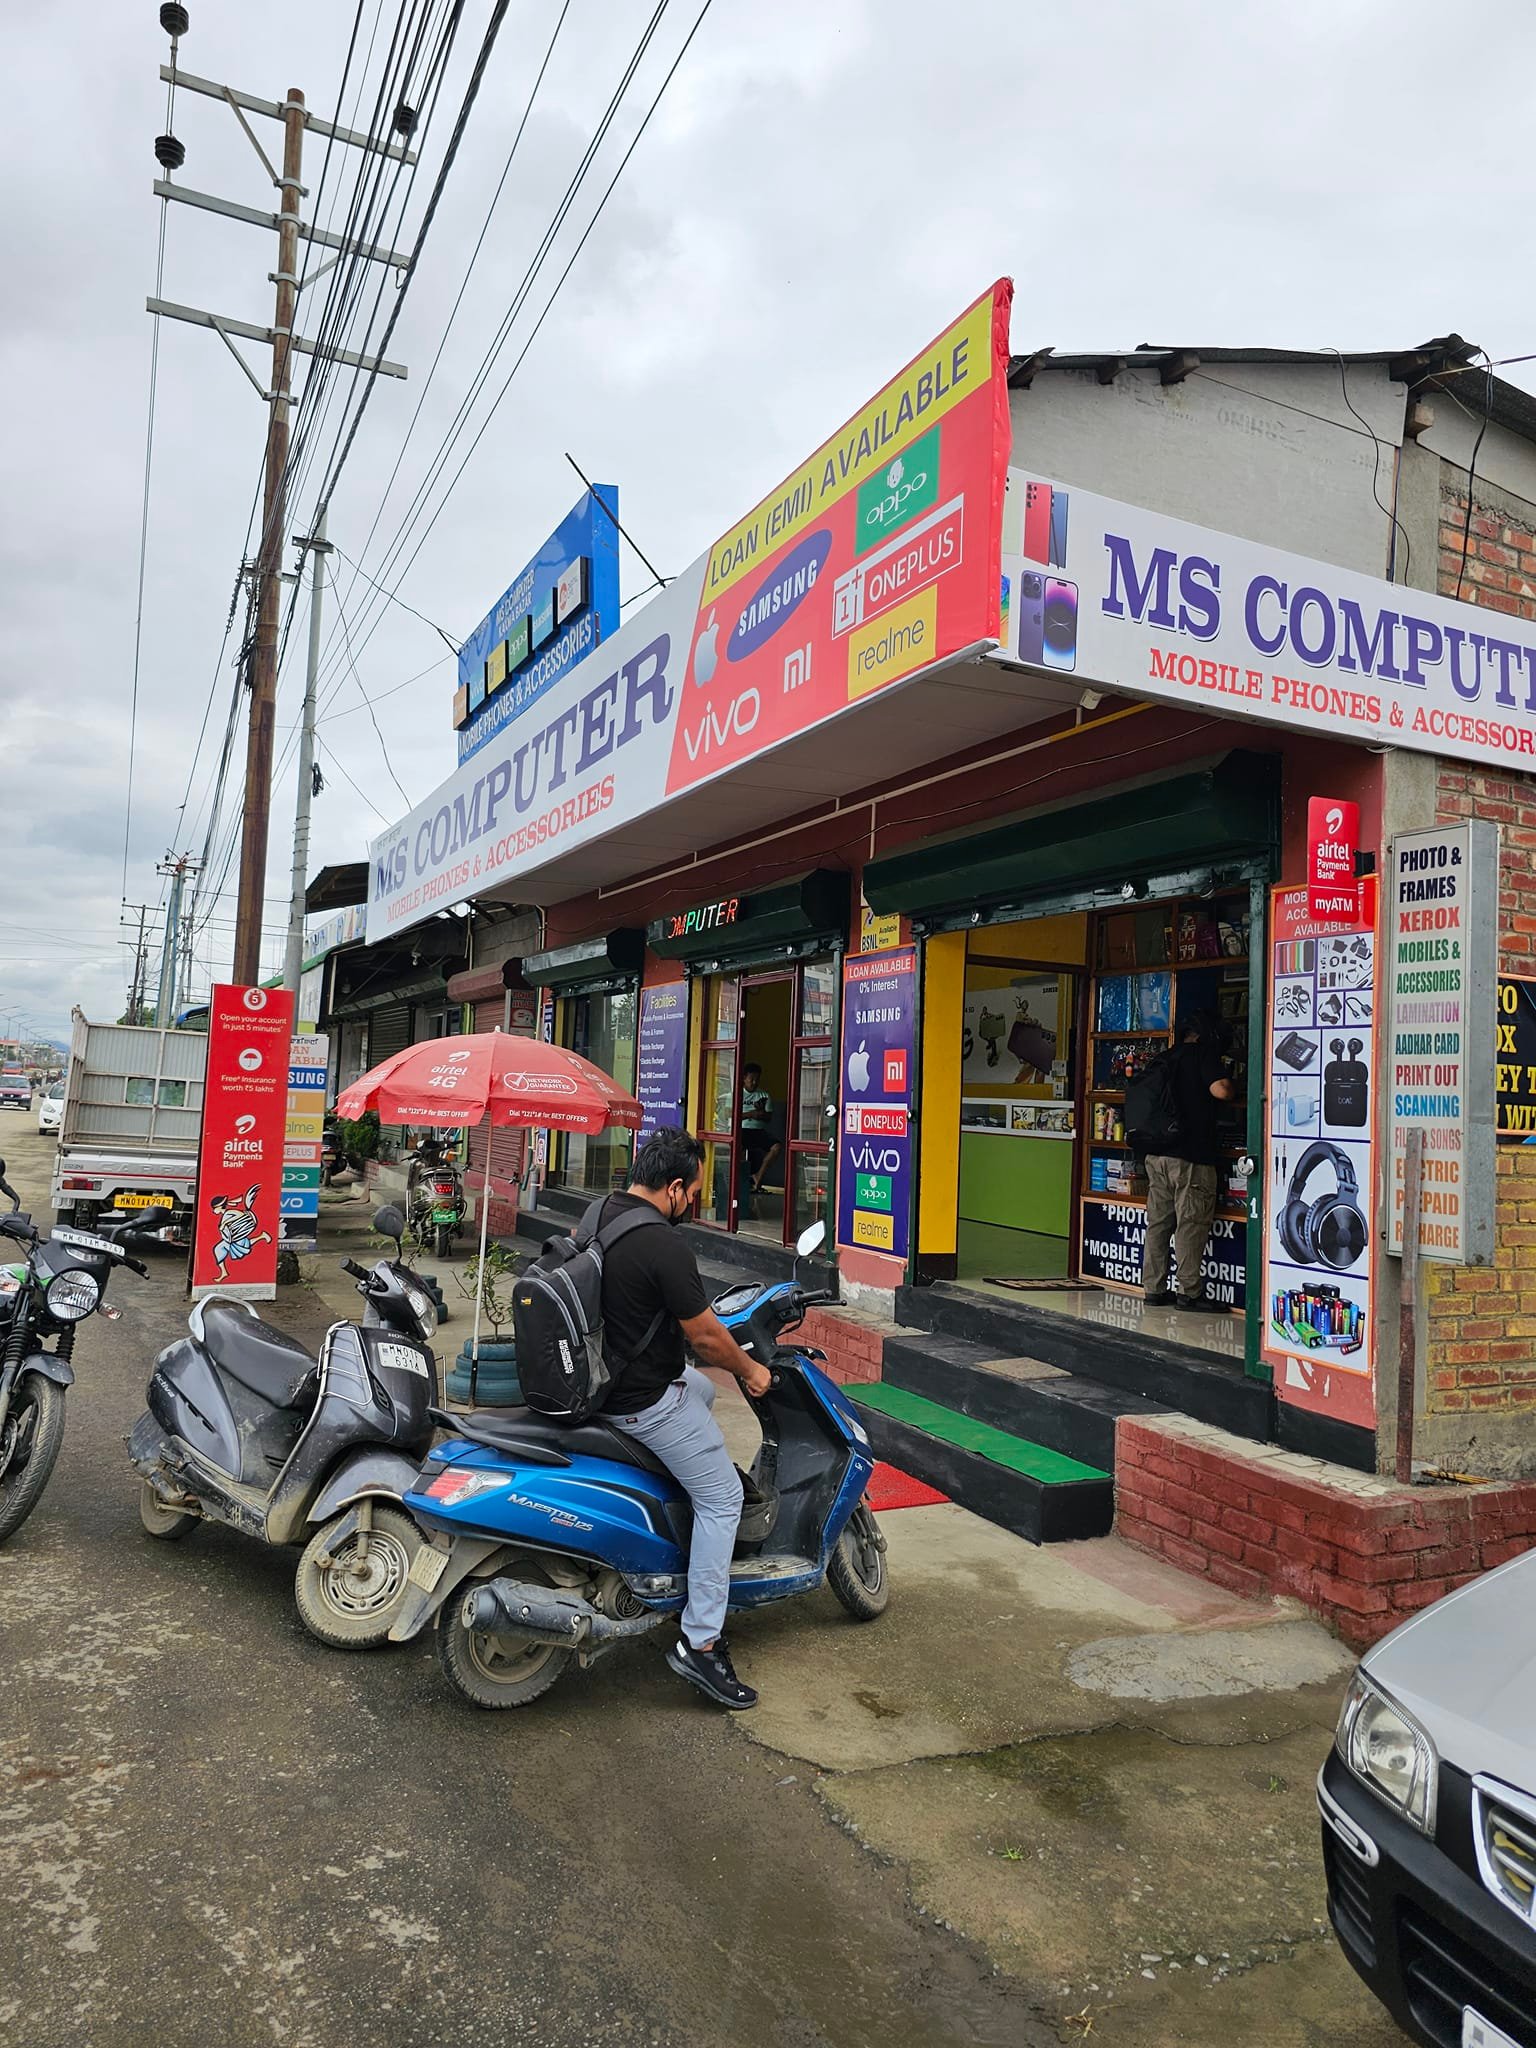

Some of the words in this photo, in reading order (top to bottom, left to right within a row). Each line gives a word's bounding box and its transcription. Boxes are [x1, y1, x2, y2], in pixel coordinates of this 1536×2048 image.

[710, 521, 759, 588] LOAN
[765, 477, 814, 544] (EMI)
[820, 337, 970, 496] AVAILABLE
[866, 471, 928, 531] oppo
[869, 527, 955, 603] ONEPLUS
[737, 559, 819, 637] SAMSUNG
[1101, 533, 1221, 643] MS
[857, 618, 926, 677] realme
[459, 715, 483, 755] MOBILE
[483, 687, 515, 735] PHONES
[515, 679, 524, 706] &
[524, 613, 592, 699] ACCESSORIES
[1148, 648, 1263, 701] MOBILE
[1272, 674, 1381, 724] PHONES
[1389, 700, 1404, 728] &
[1412, 706, 1536, 756] ACCESSOR
[683, 686, 761, 762] vivo
[374, 837, 409, 903] MS
[415, 632, 674, 877] COMPUTER
[386, 888, 421, 924] MOBILE
[422, 859, 470, 905] PHONES
[472, 854, 482, 878] &
[485, 773, 615, 872] ACCESSORIES
[1317, 840, 1350, 860] airtel
[1317, 858, 1349, 872] Payments
[1399, 845, 1448, 873] PHOTO
[1451, 846, 1462, 866] &
[1317, 869, 1335, 880] Bank
[1399, 875, 1456, 904] FRAMES
[1315, 897, 1353, 914] myATM
[1294, 921, 1352, 937] AVAILABLE
[1399, 906, 1460, 933] XEROX
[879, 926, 898, 934] Available
[861, 933, 879, 952] BSNL
[1398, 939, 1449, 964] MOBILES
[1451, 940, 1461, 960] &
[848, 965, 869, 979] LOAN
[869, 957, 912, 976] AVAILABLE
[859, 981, 870, 994] 0%
[871, 978, 898, 993] Interest
[1396, 969, 1461, 994] ACCESSORIES
[251, 994, 259, 1003] 5
[650, 994, 677, 1009] Facilities
[220, 1013, 240, 1023] Open
[855, 1006, 901, 1025] SAMSUNG
[1396, 1001, 1459, 1024] LAMINATION
[230, 1023, 245, 1031] just
[1395, 1033, 1432, 1055] AADHAR
[1434, 1032, 1460, 1055] CARD
[241, 1075, 277, 1084] Insurance
[288, 1071, 326, 1085] SUNG
[431, 1064, 468, 1076] airtel
[1395, 1064, 1431, 1086] PRINT
[1434, 1064, 1459, 1087] OUT
[254, 1085, 274, 1093] lakhs
[428, 1075, 459, 1089] 4G
[529, 1082, 571, 1090] GUARANTEE
[428, 1109, 437, 1117] for
[437, 1110, 450, 1118] BEST
[451, 1111, 469, 1119] OFFER
[509, 1109, 521, 1117] Dial
[551, 1112, 566, 1121] BEST
[566, 1113, 589, 1123] OFFERS
[1395, 1094, 1460, 1118] SCANNING
[286, 1121, 315, 1134] alme
[863, 1114, 905, 1130] ONEPLUS
[223, 1138, 263, 1153] airtel
[1430, 1128, 1461, 1151] SONGS
[223, 1152, 263, 1161] Payments
[286, 1146, 312, 1157] EPLUS
[850, 1140, 900, 1172] vivo
[222, 1160, 244, 1168] Bank
[1395, 1158, 1459, 1184] ETRIC
[282, 1172, 308, 1184] po
[860, 1188, 887, 1200] oppo
[1395, 1189, 1459, 1216] PPAID
[1249, 1197, 1258, 1219] 1
[857, 1219, 889, 1239] realme
[1395, 1220, 1459, 1249] RHARGE
[1206, 1281, 1235, 1304] SIM
[507, 1493, 579, 1522] MAESTRO
[574, 1520, 594, 1532] 125
